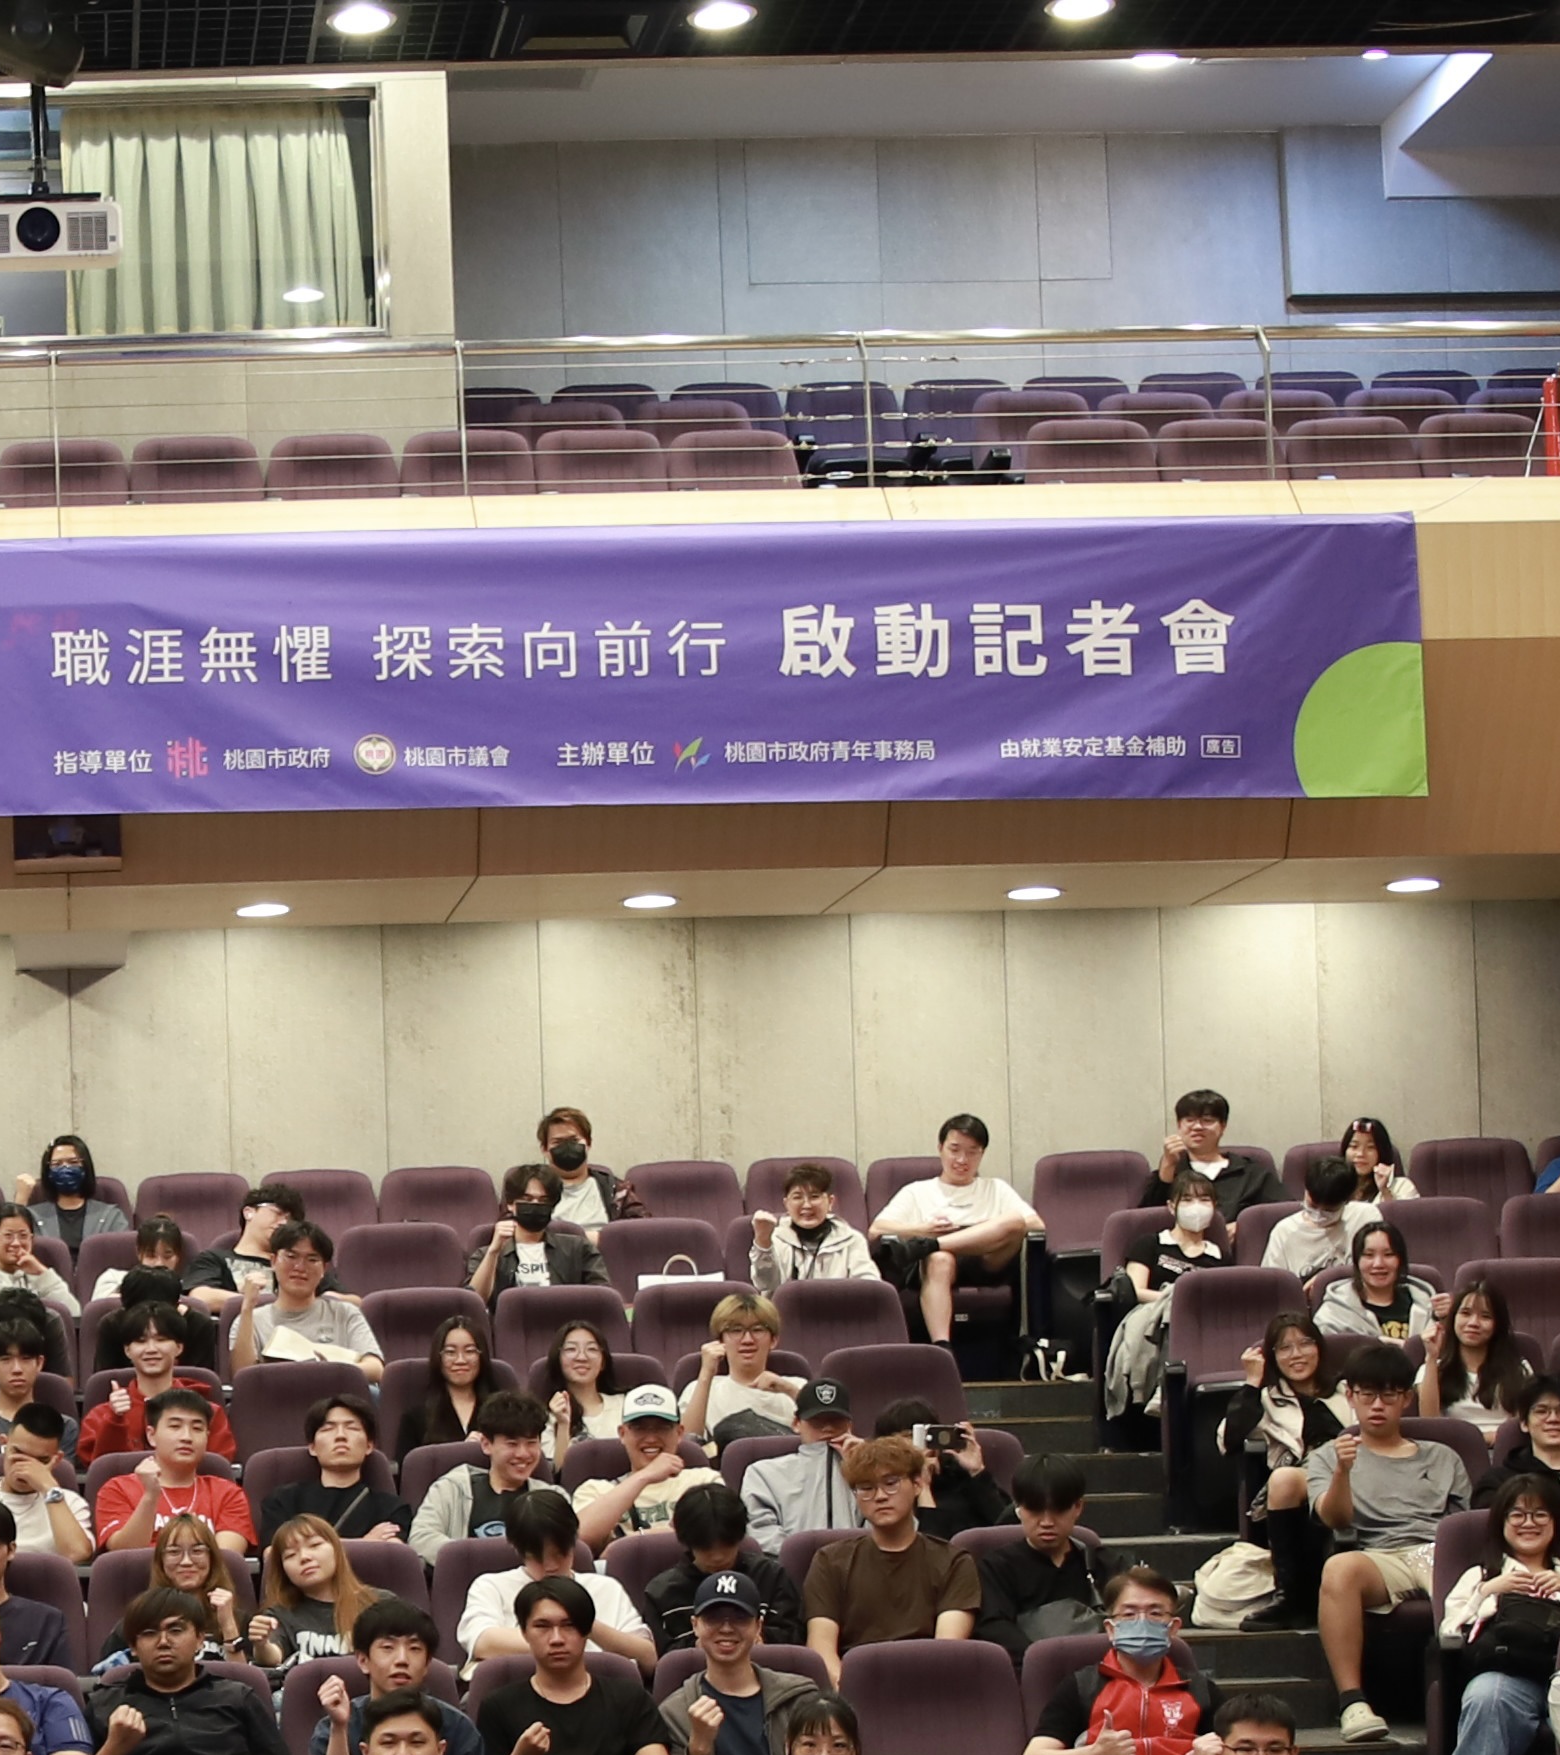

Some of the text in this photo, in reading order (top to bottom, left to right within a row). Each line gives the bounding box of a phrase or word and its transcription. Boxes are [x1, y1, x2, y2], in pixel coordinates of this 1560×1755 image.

[50, 598, 1236, 688] 職涯無懼 探索向前行 啟動記者會
[52, 748, 153, 777] 指導單位
[222, 746, 332, 772] 桃園市政府
[403, 745, 511, 770] 桃園市議會
[556, 741, 656, 769] 主辦單位
[723, 737, 937, 765] 桃園市政府青年事務局
[999, 734, 1187, 761] 由就業安定基金補助
[1206, 738, 1236, 757] 廣告
